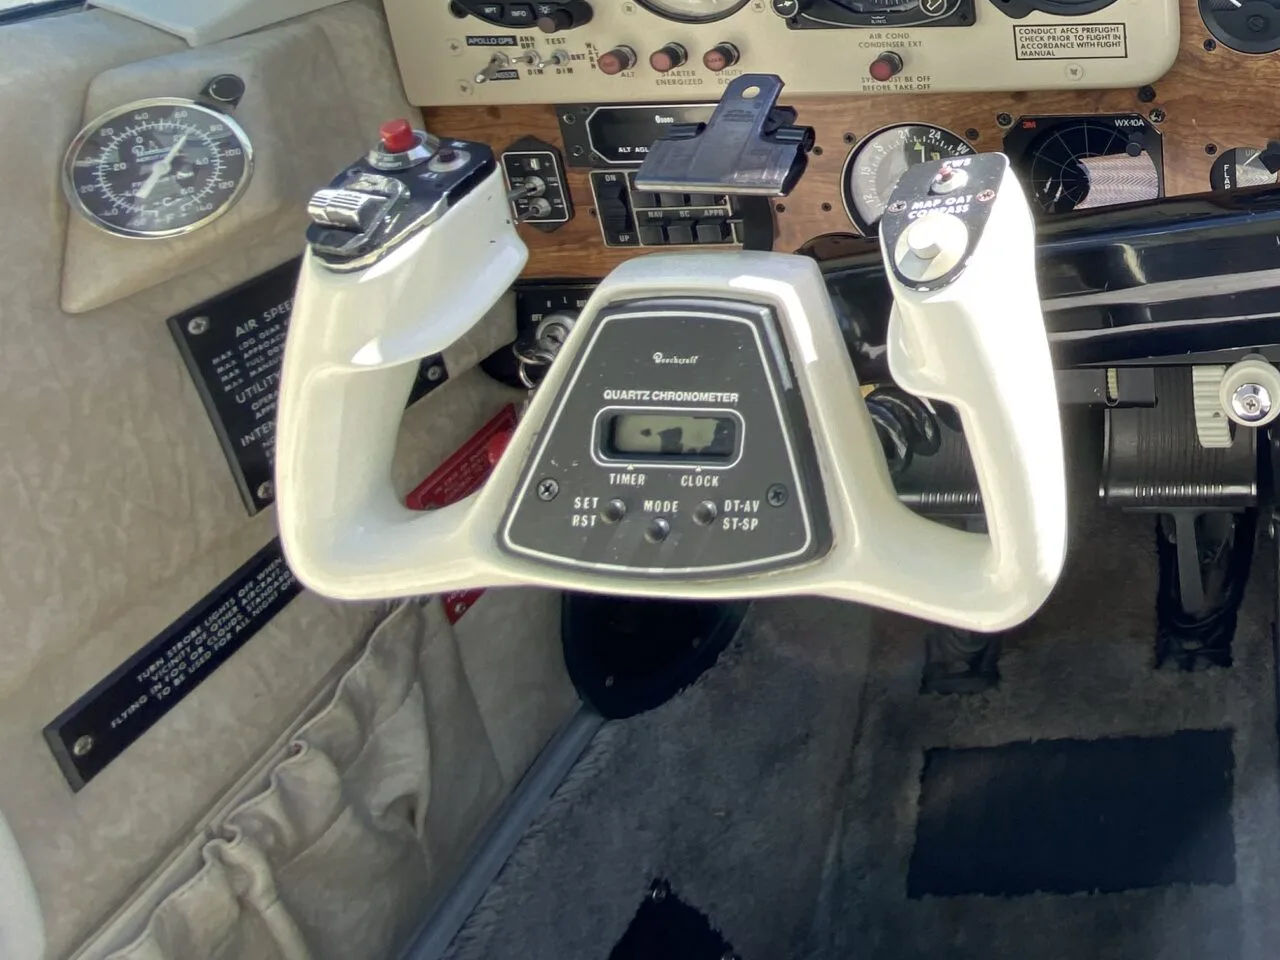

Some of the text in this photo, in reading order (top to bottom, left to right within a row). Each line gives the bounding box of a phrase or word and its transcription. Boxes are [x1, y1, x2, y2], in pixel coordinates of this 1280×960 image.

[1022, 121, 1036, 129] 3M
[605, 174, 616, 182] ON
[912, 195, 972, 209] MAP OAT
[236, 319, 258, 338] AIR
[604, 390, 738, 402] QUARTZ CHRONOMETER
[609, 473, 645, 485] TIMER
[681, 475, 719, 487] CLOCK
[574, 498, 599, 508] SET
[644, 501, 679, 512] MODE
[724, 500, 759, 512] DT-AV
[572, 515, 597, 526] RST
[723, 518, 759, 530] ST-SP
[167, 597, 236, 656] STROBE LIGHTS
